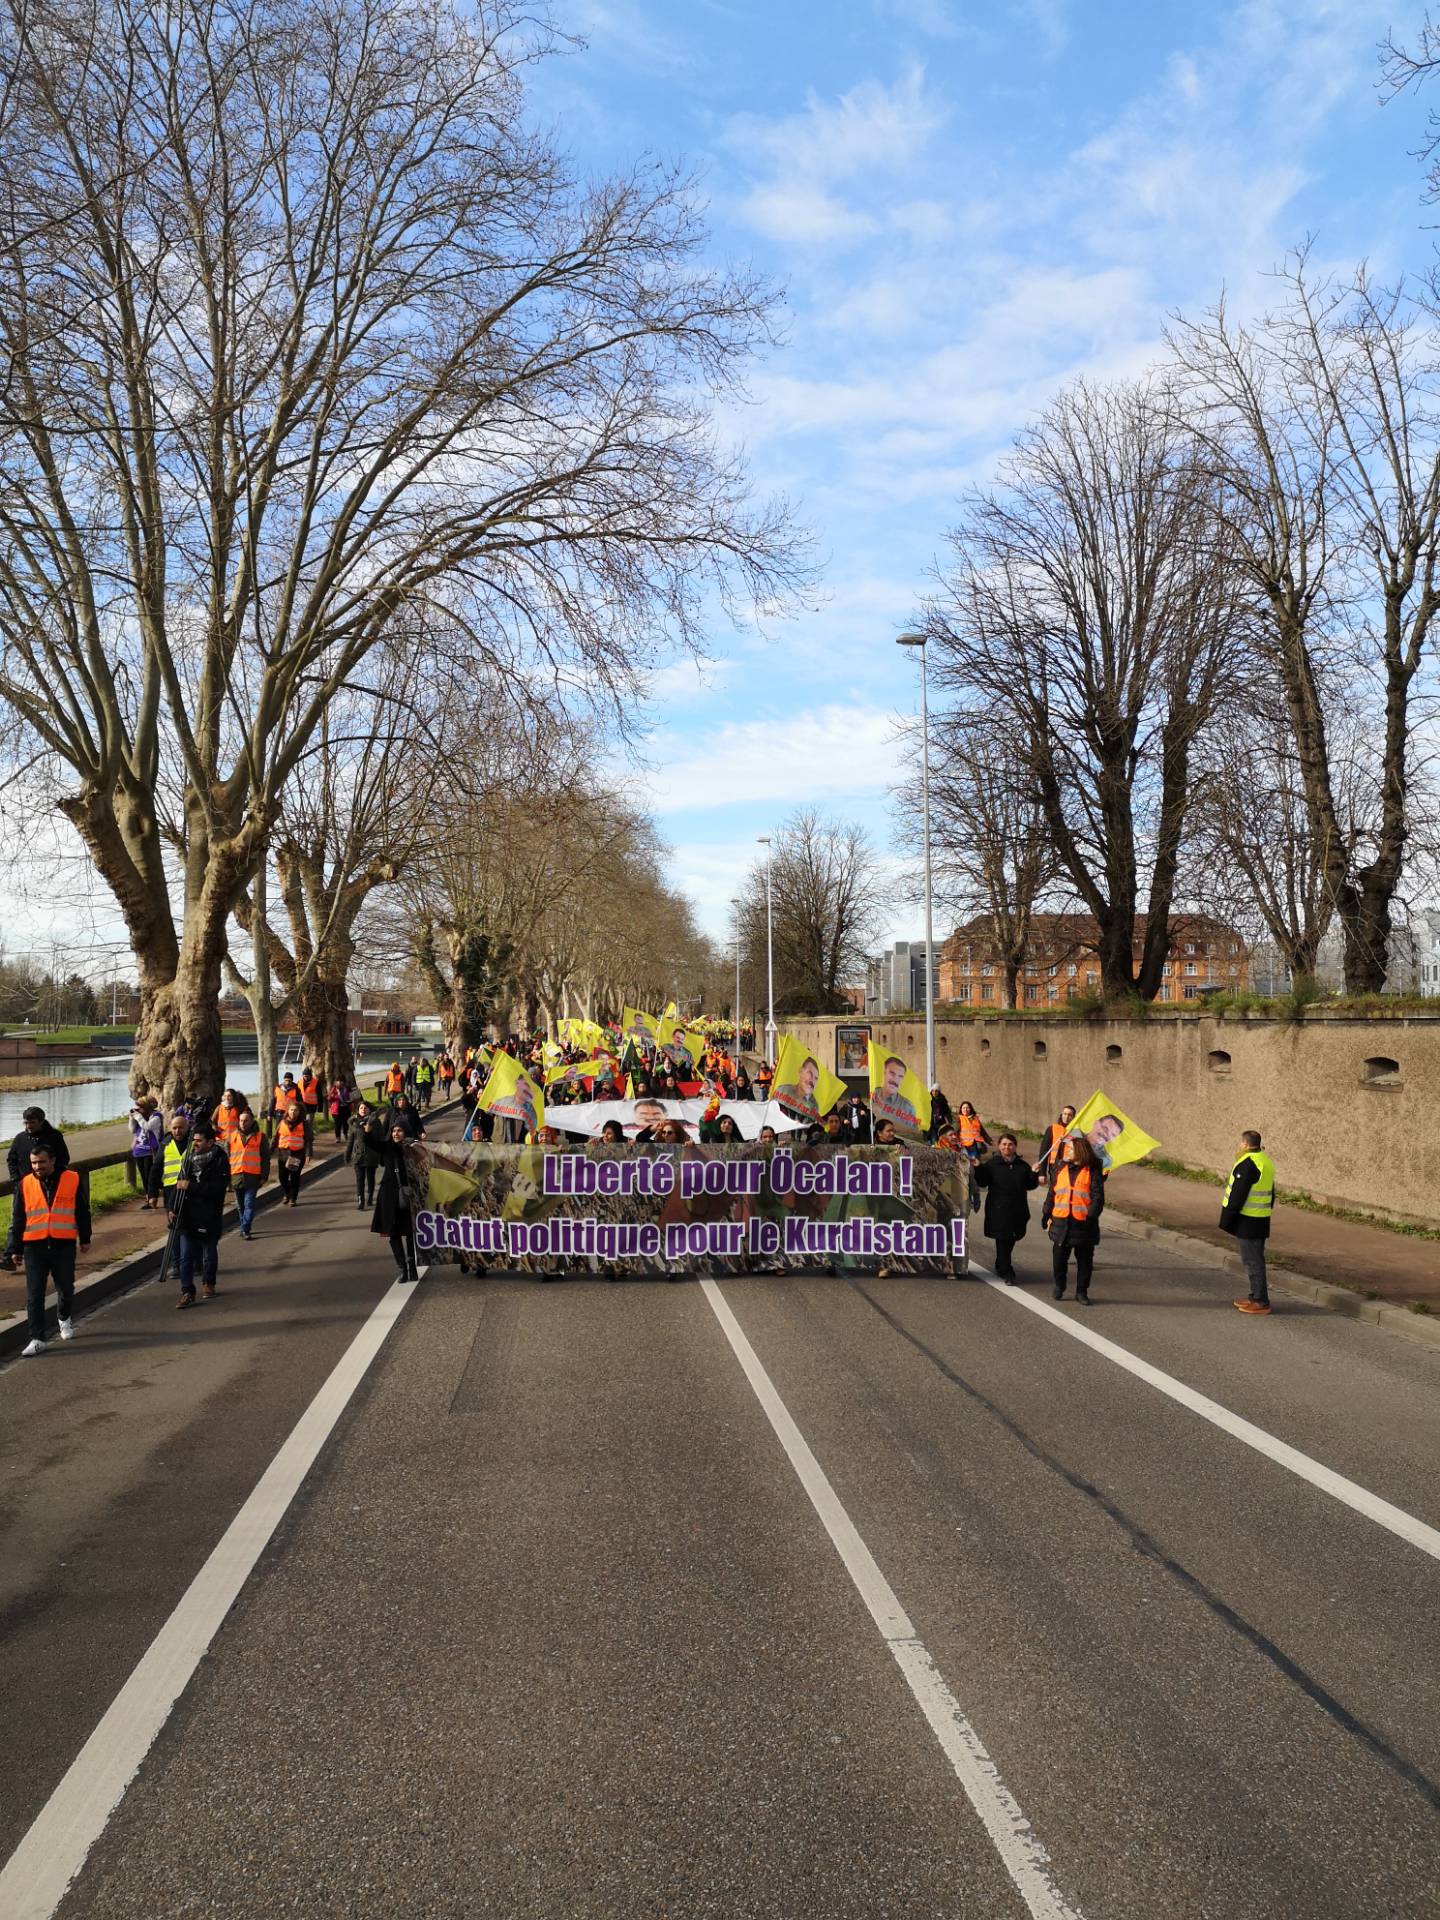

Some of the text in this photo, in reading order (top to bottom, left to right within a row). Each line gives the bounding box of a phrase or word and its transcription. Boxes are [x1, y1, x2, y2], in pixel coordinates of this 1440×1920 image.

[544, 1148, 913, 1199] Liberté pour Öcalan !
[415, 1210, 966, 1260] Statut politique pour le Kurdistan !
